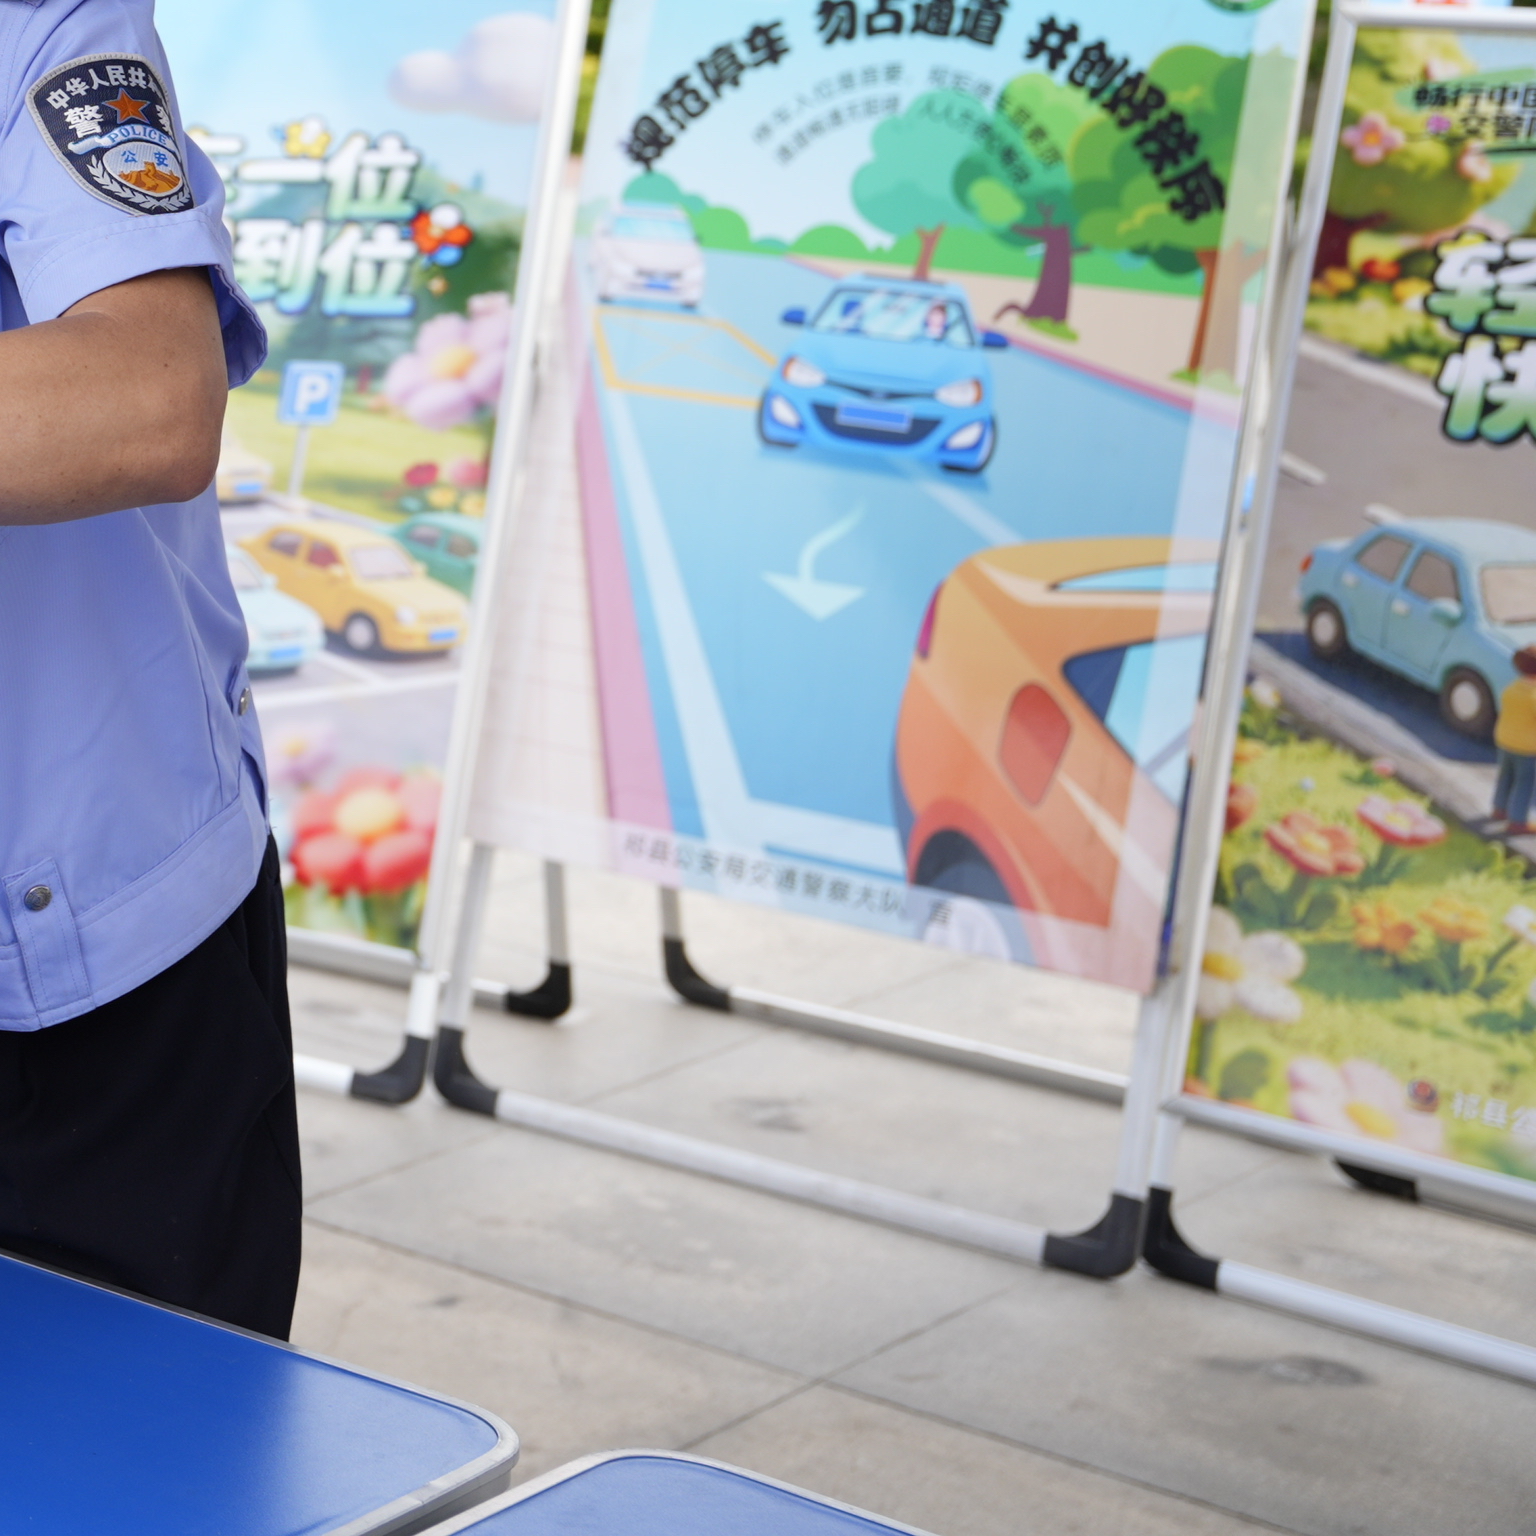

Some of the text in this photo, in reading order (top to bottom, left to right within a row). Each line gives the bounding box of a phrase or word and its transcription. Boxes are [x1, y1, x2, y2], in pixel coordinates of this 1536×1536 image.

[46, 64, 159, 110] 中华人民共
[108, 124, 168, 146] POLICE
[626, 17, 792, 173] 规范停车
[1024, 15, 1227, 223] 共创好秩序
[1459, 113, 1536, 138] 交警
